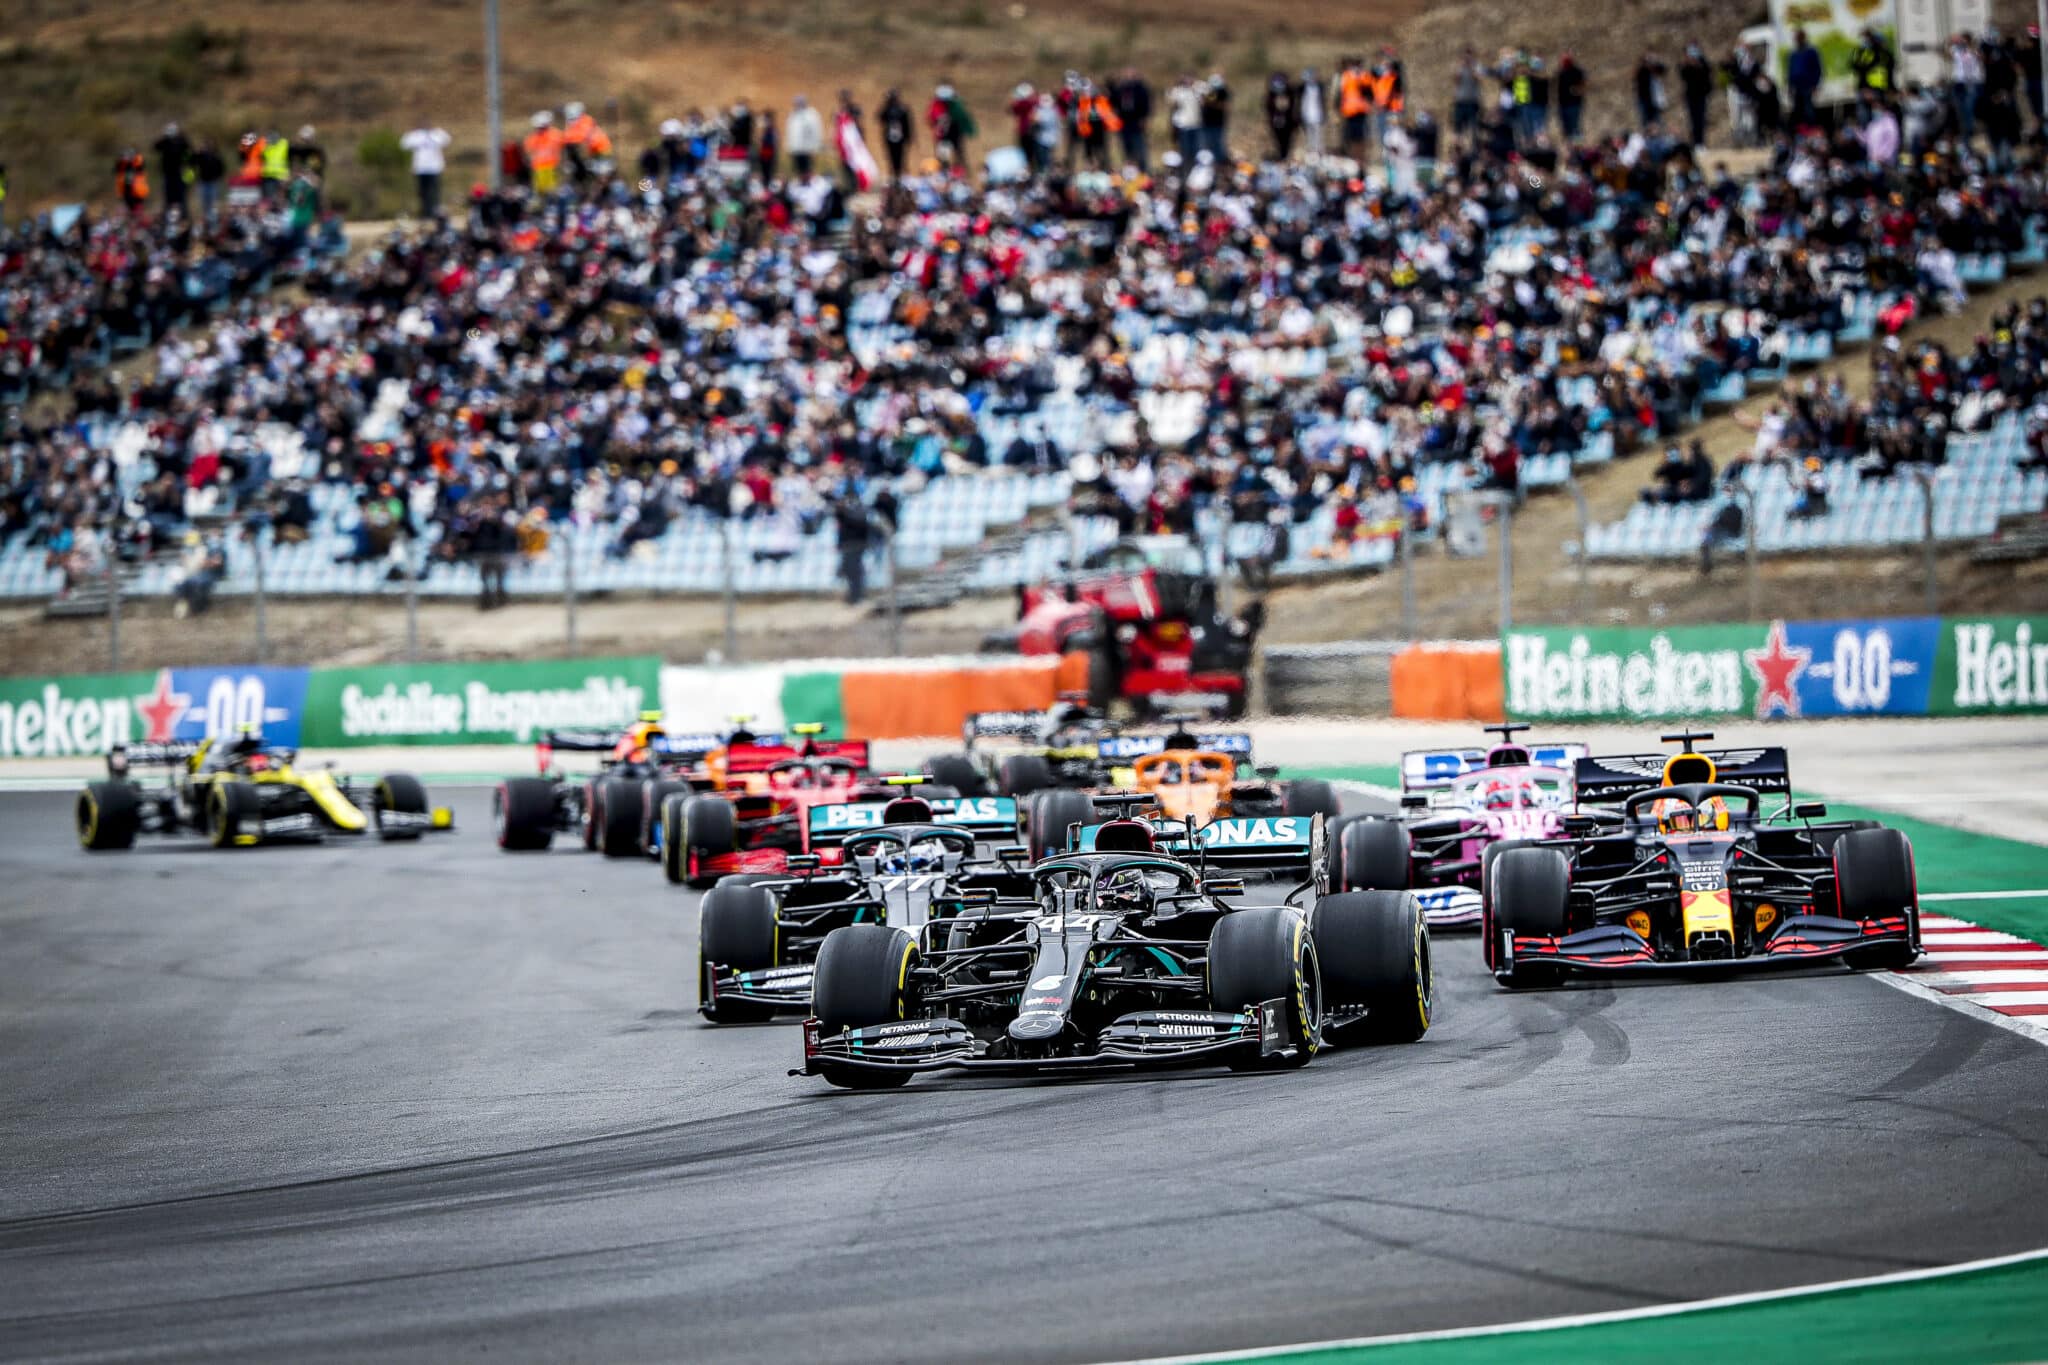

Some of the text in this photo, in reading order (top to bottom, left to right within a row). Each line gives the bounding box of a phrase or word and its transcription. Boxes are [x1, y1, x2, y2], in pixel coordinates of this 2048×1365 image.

[1507, 631, 1744, 715] Heineken
[1954, 622, 2048, 706] Hein
[827, 798, 999, 827] PETNAS
[884, 874, 933, 892] 77
[1037, 914, 1097, 933] 44
[1155, 1012, 1214, 1022] PETRONAS
[879, 1021, 932, 1035] PETRONAS
[1158, 1023, 1216, 1036] SYNTIUM
